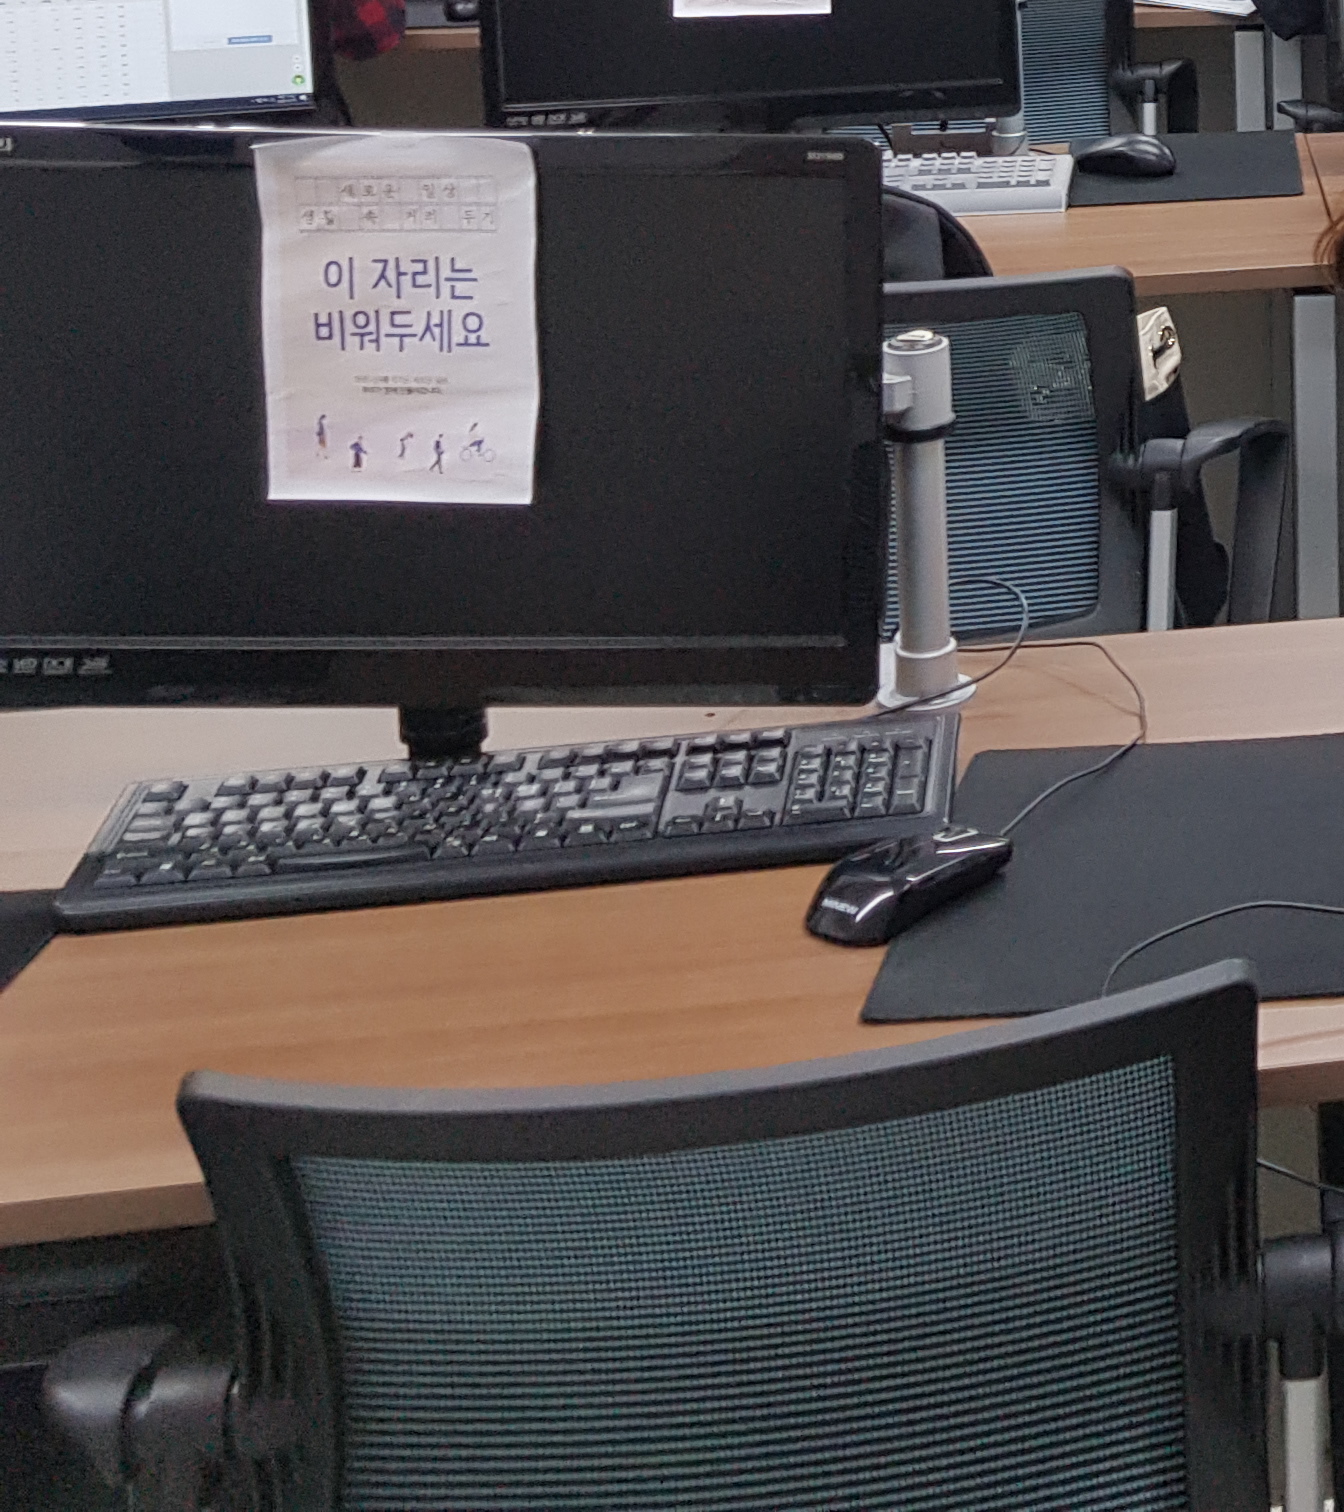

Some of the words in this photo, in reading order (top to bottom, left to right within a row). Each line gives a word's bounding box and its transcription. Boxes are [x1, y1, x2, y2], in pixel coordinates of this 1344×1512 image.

[340, 183, 396, 199] 새로운
[422, 183, 457, 199] 일상
[301, 209, 335, 226] 생활
[362, 209, 378, 225] 속
[406, 208, 437, 225] 거리
[462, 209, 494, 225] 두기
[323, 256, 355, 300] 이
[371, 256, 478, 301] 자리는
[313, 308, 491, 354] 비워두세요
